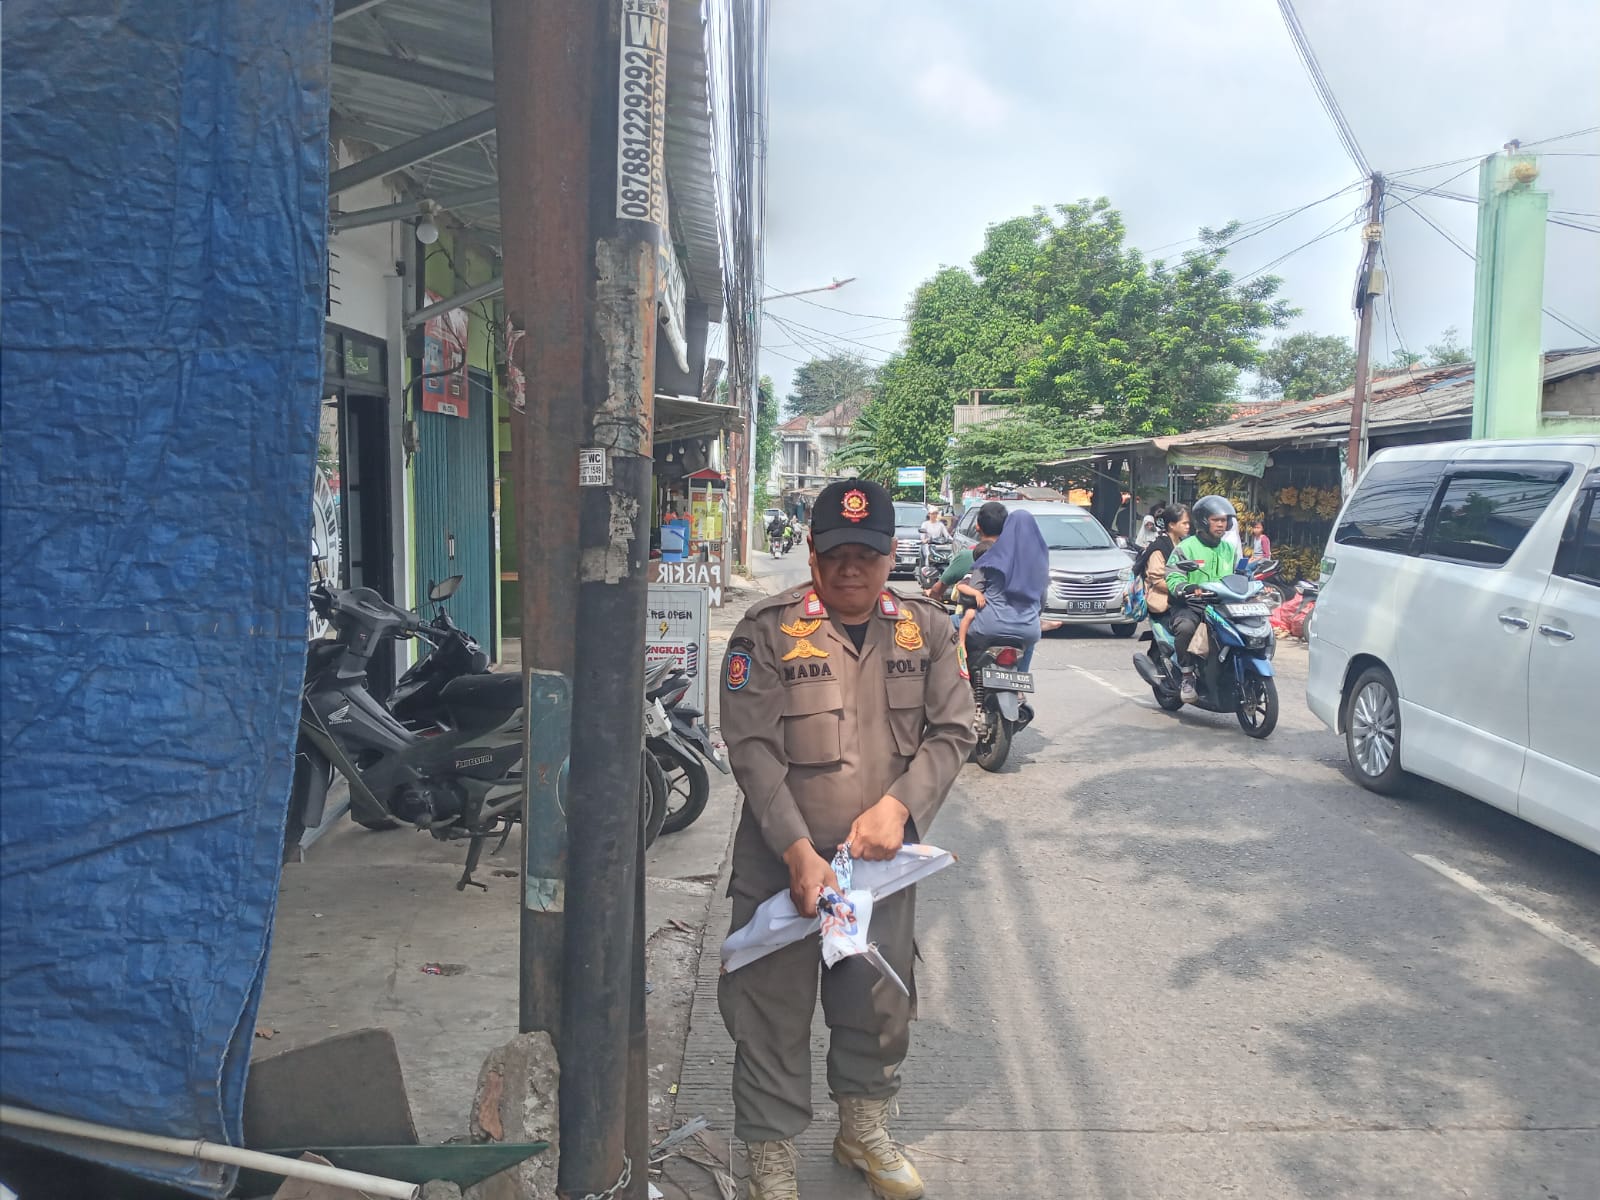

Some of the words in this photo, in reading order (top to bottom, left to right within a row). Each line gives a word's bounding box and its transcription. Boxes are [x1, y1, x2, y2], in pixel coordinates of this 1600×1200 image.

[621, 51, 654, 218] 087881229292
[588, 453, 601, 463] WC
[667, 609, 692, 620] OPEN
[649, 646, 686, 655] NGKAS
[887, 659, 916, 674] POL
